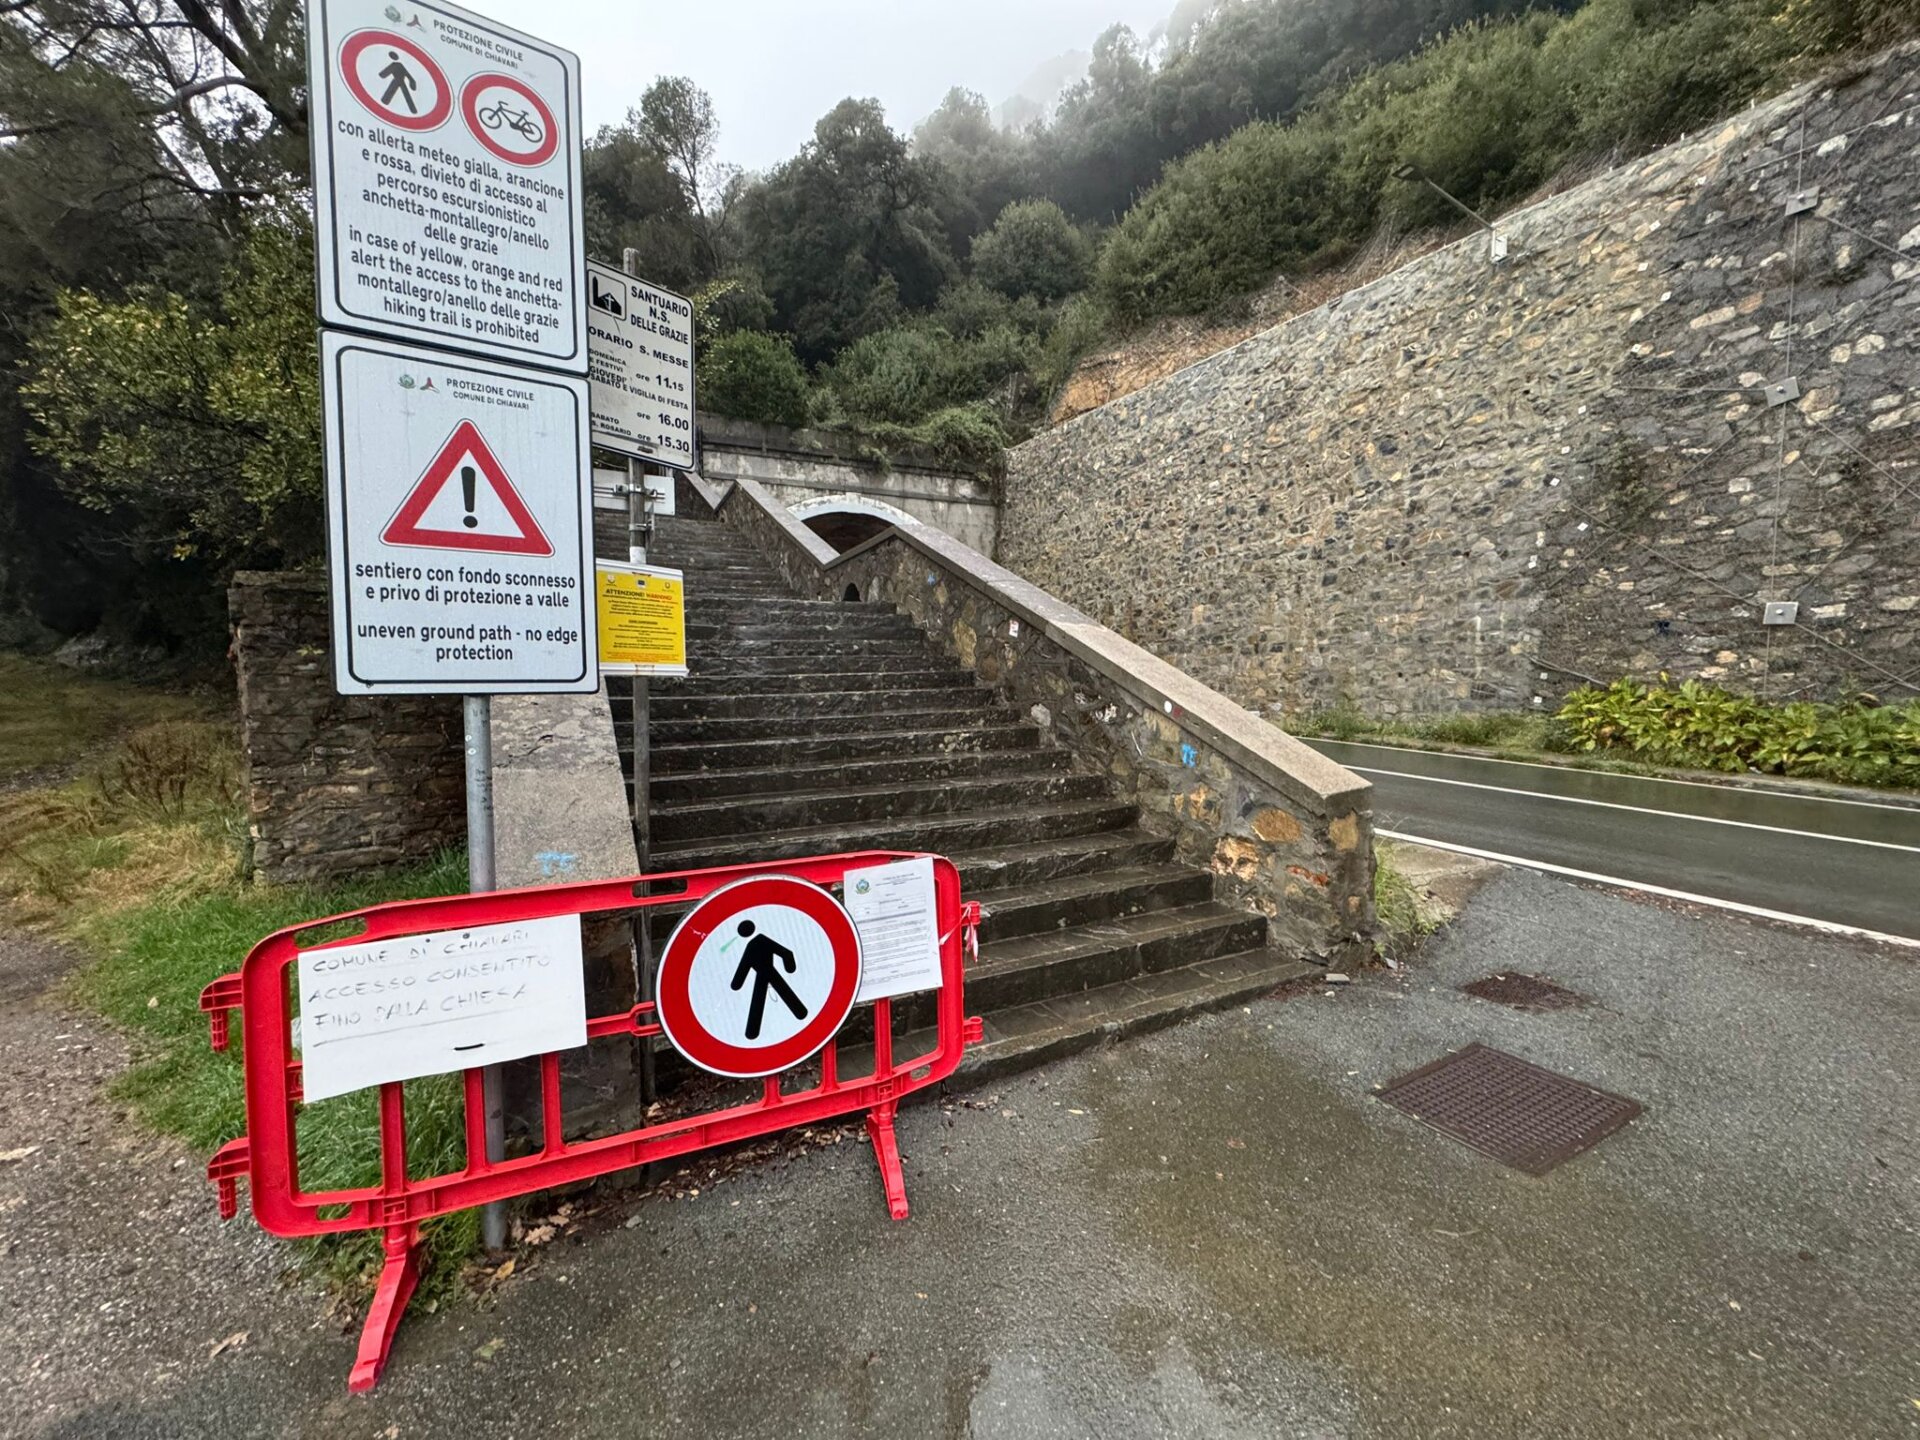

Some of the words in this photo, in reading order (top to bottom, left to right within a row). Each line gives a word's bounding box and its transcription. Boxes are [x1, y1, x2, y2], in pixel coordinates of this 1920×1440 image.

[433, 19, 493, 50] PROTEZIONE
[495, 43, 523, 62] CIVILE
[440, 34, 477, 53] COMUNE
[475, 48, 482, 56] DI
[485, 52, 518, 70] CHIAVARI
[338, 120, 364, 139] con
[368, 128, 414, 154] allerta
[419, 144, 460, 168] meteo
[464, 158, 502, 182] gialla,
[506, 172, 564, 200] arancione
[362, 148, 370, 160] e
[374, 152, 416, 176] rossa,
[421, 163, 466, 188] divieto
[470, 178, 481, 194] di
[485, 184, 533, 208] accesso
[536, 198, 548, 214] al
[377, 172, 438, 200] percorso
[442, 192, 536, 228] escursionistico
[362, 188, 549, 250] anchetta-montallegro/anello
[424, 223, 456, 244] delle
[460, 235, 498, 256] grazie
[349, 224, 362, 243] in
[366, 233, 398, 252] case
[402, 240, 416, 256] of
[420, 246, 467, 269] yellow,
[472, 259, 515, 282] orange
[518, 270, 540, 286] and
[544, 277, 562, 292] red
[351, 248, 386, 270] alert
[389, 256, 412, 276] the
[416, 266, 460, 287] access
[464, 274, 478, 291] to
[482, 278, 502, 297] the
[506, 287, 562, 310] anchetta-
[358, 272, 486, 313] montallegro/anello
[490, 300, 520, 320] delle
[524, 311, 559, 329] grazie
[631, 286, 688, 318] SANTUARIO
[649, 306, 670, 324] N.S.
[384, 296, 426, 322] hiking
[430, 306, 458, 326] trail
[461, 313, 472, 329] is
[476, 320, 539, 344] prohibited
[630, 314, 657, 334] DELLE
[659, 324, 688, 344] GRAZIE
[588, 326, 633, 349] ORARIO
[640, 345, 650, 356] S.
[653, 350, 688, 368] MESSE
[590, 348, 626, 366] DOMENICA
[596, 358, 624, 372] FESTIVI
[446, 378, 504, 396] PROTEZIONE
[506, 389, 534, 401] CIVILE
[590, 374, 621, 388] SABATO
[622, 384, 628, 392] E
[630, 386, 656, 400] VIGILIA
[658, 395, 665, 404] DI
[667, 398, 688, 410] FESTA
[636, 372, 650, 382] ore
[656, 374, 684, 392] 11.15
[452, 390, 485, 403] COMUNE
[496, 398, 529, 410] CHIAVARI
[591, 412, 620, 424] SABATO
[636, 412, 651, 420] ore
[658, 412, 689, 430] 16.00
[600, 420, 632, 436] ROSARIO
[638, 434, 651, 442] ore
[658, 434, 690, 453] 15.30
[355, 562, 422, 580] sentiero
[426, 568, 454, 582] con
[458, 566, 500, 585] fondo
[505, 573, 576, 588] sconnesso
[366, 586, 375, 599] e
[380, 584, 420, 602] privo
[426, 585, 439, 602] di
[444, 588, 521, 606] protezione
[525, 594, 534, 606] a
[538, 592, 570, 607] valle
[358, 624, 415, 638] uneven
[420, 624, 474, 642] ground
[480, 624, 512, 642] path
[526, 629, 542, 641] no
[546, 626, 578, 645] edge
[436, 644, 512, 663] protection
[312, 950, 388, 972] COMUNE
[308, 976, 416, 1002] ACCESSO
